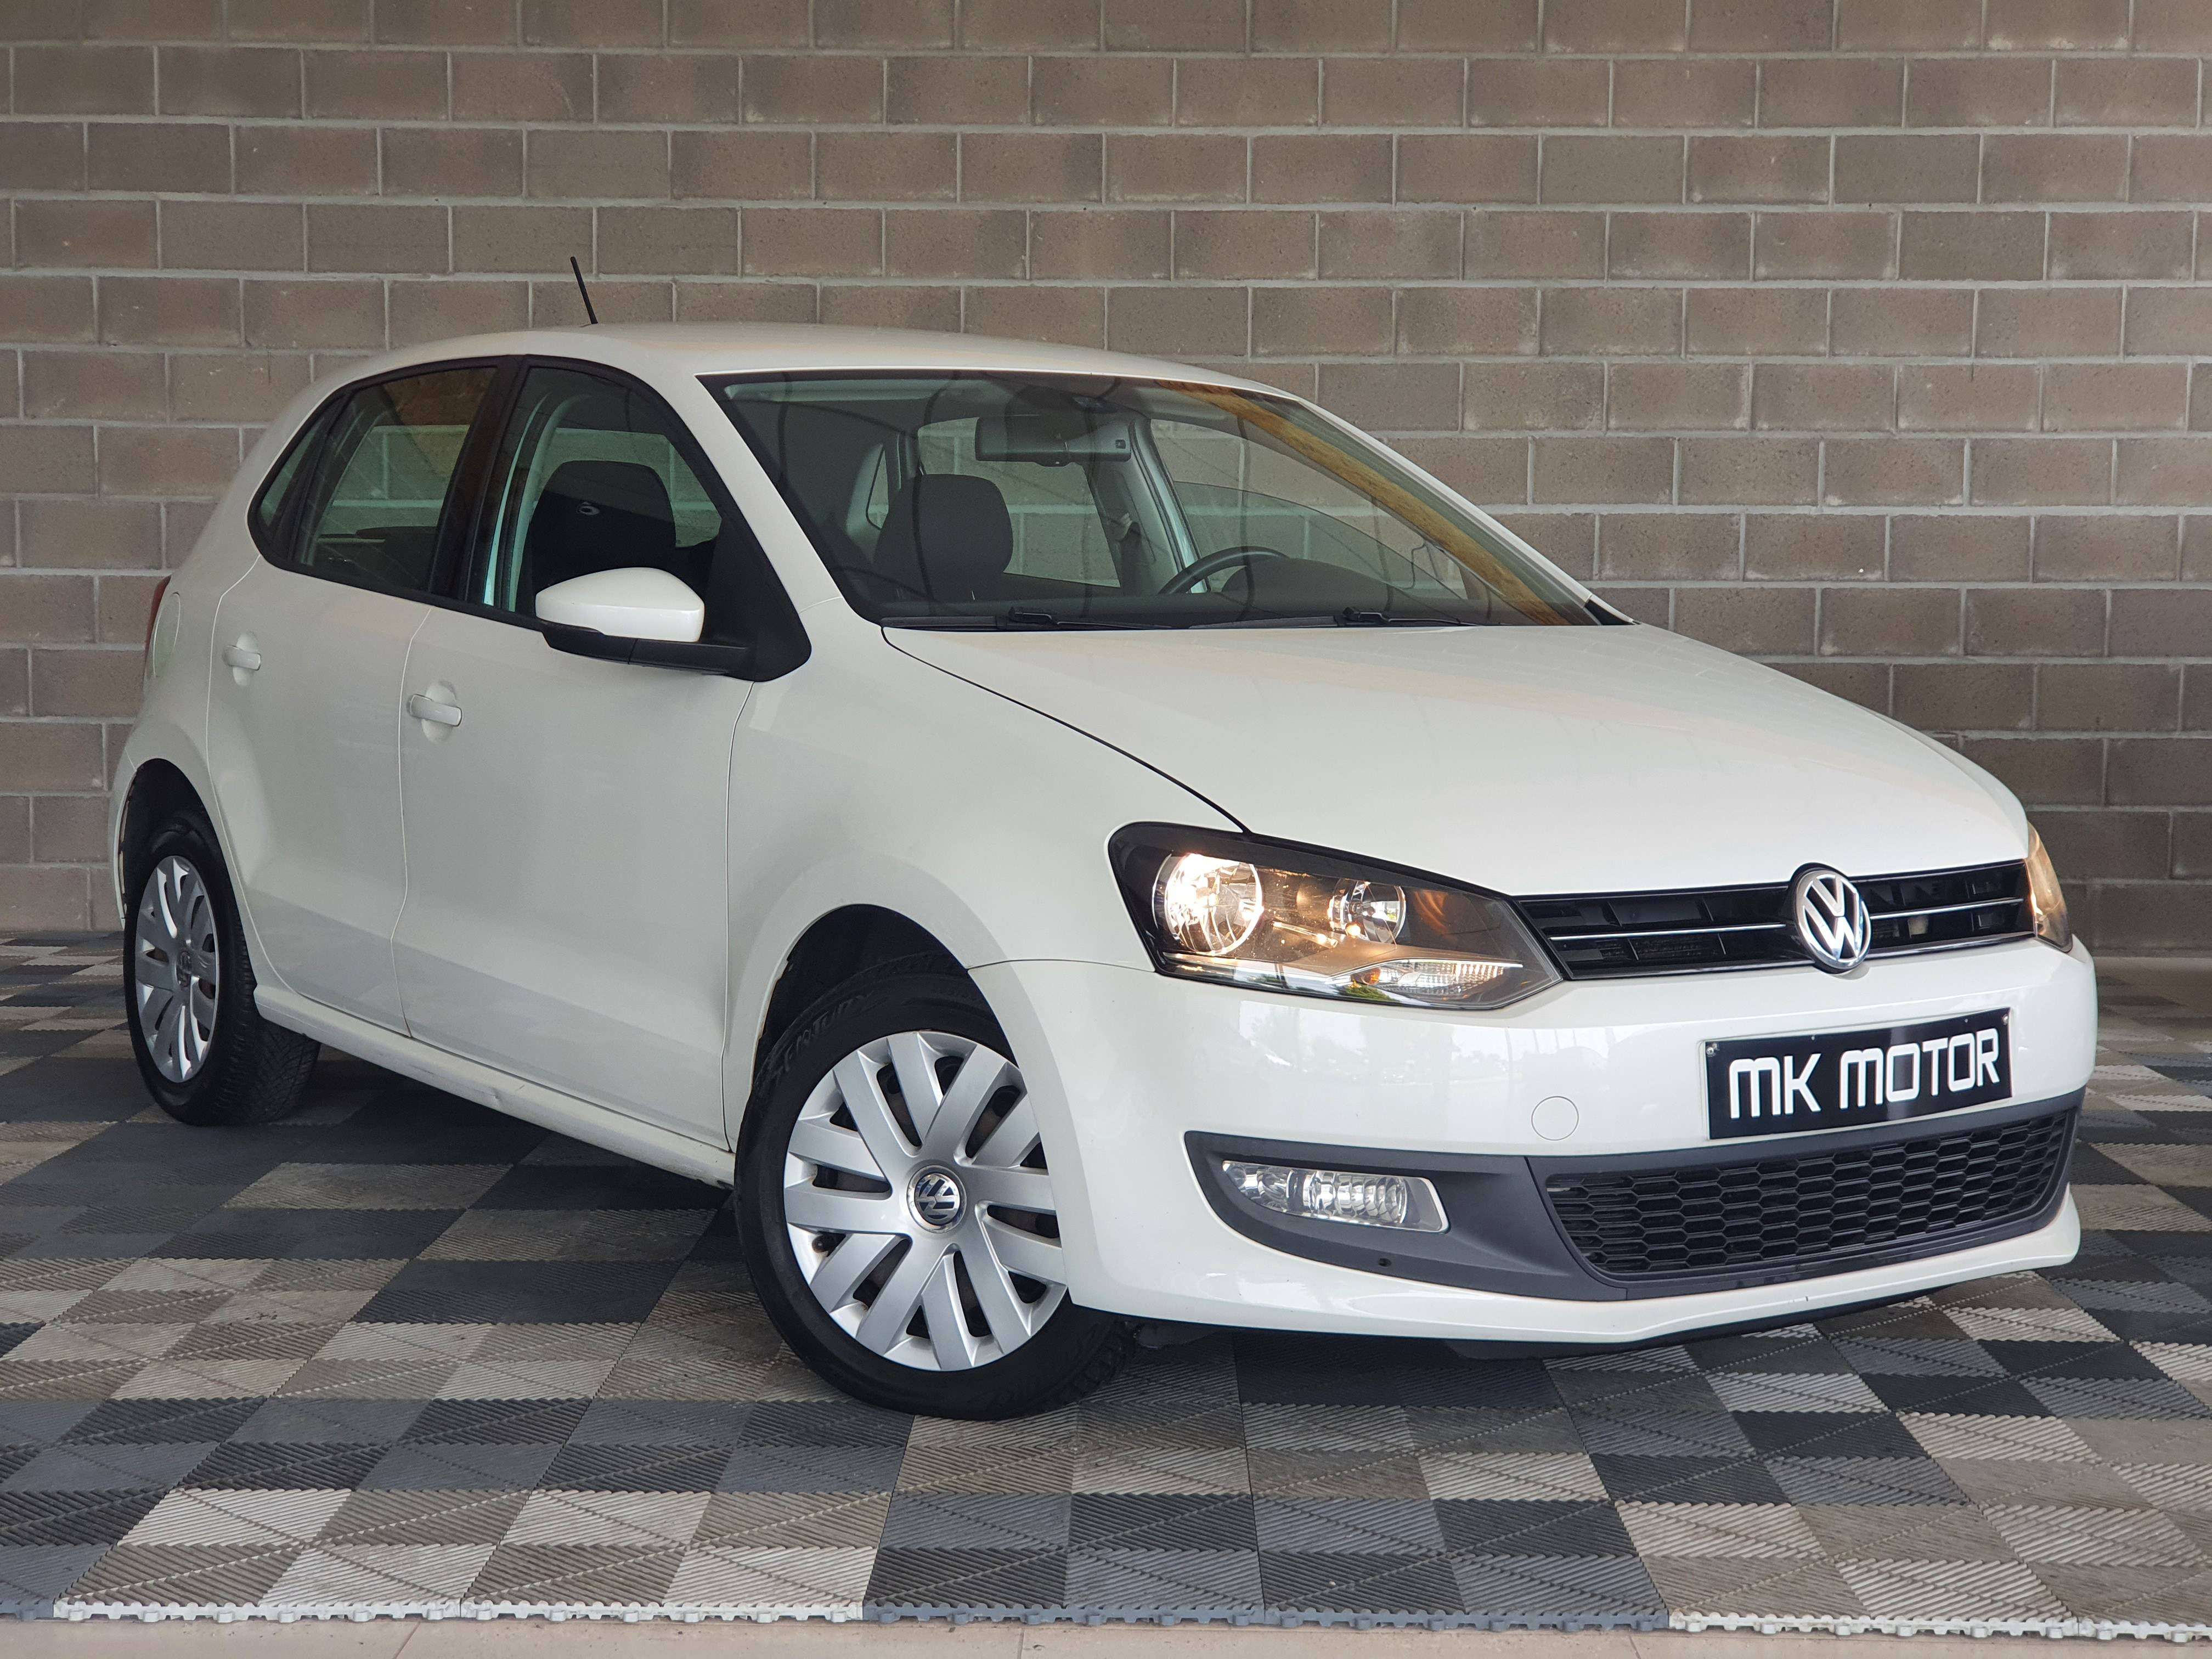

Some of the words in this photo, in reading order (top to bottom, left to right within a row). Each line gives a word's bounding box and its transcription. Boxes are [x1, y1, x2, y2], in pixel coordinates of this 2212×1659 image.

[1796, 871, 1871, 968] VW
[1729, 1053, 1821, 1119] MK
[1839, 1028, 2000, 1109] MOTOR
